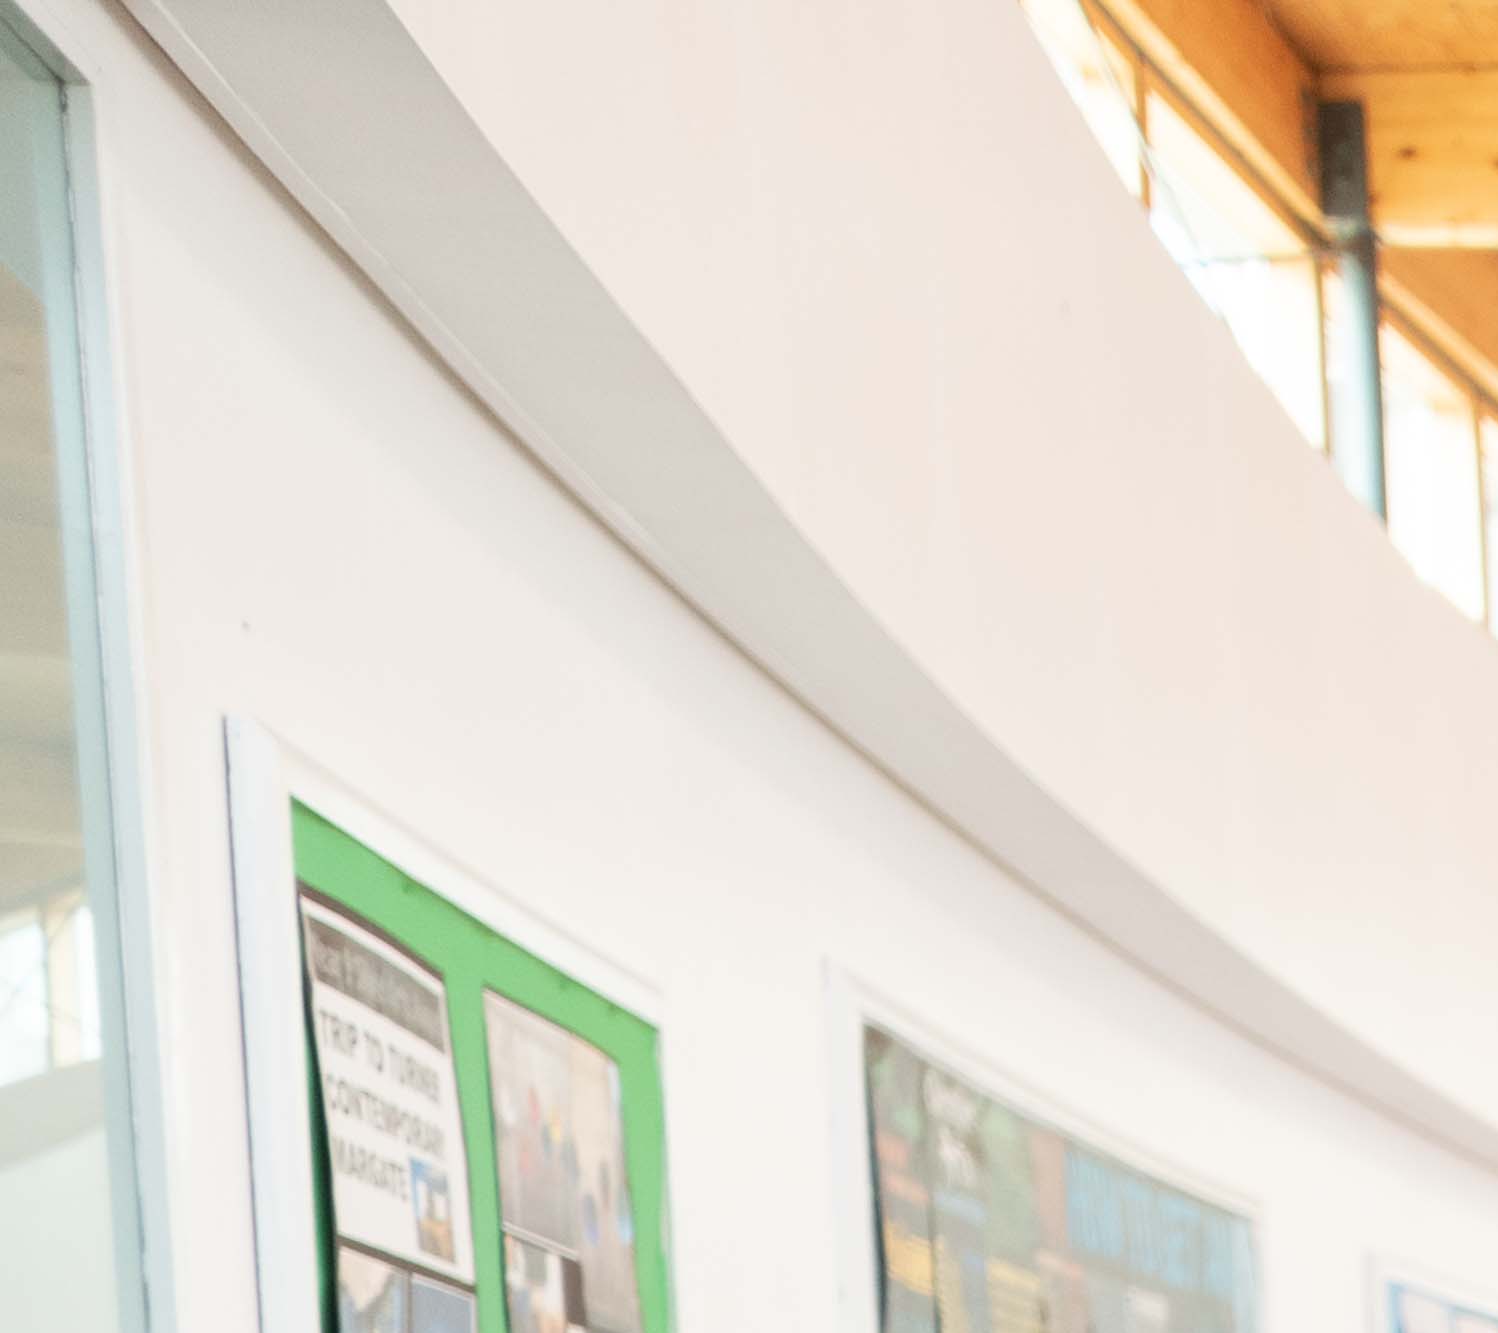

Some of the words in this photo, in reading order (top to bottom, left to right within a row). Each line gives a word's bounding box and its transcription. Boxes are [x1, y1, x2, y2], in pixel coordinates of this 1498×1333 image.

[318, 1008, 357, 1057] TRIP
[362, 1028, 384, 1073] TO
[332, 1134, 408, 1203] MARGATE
